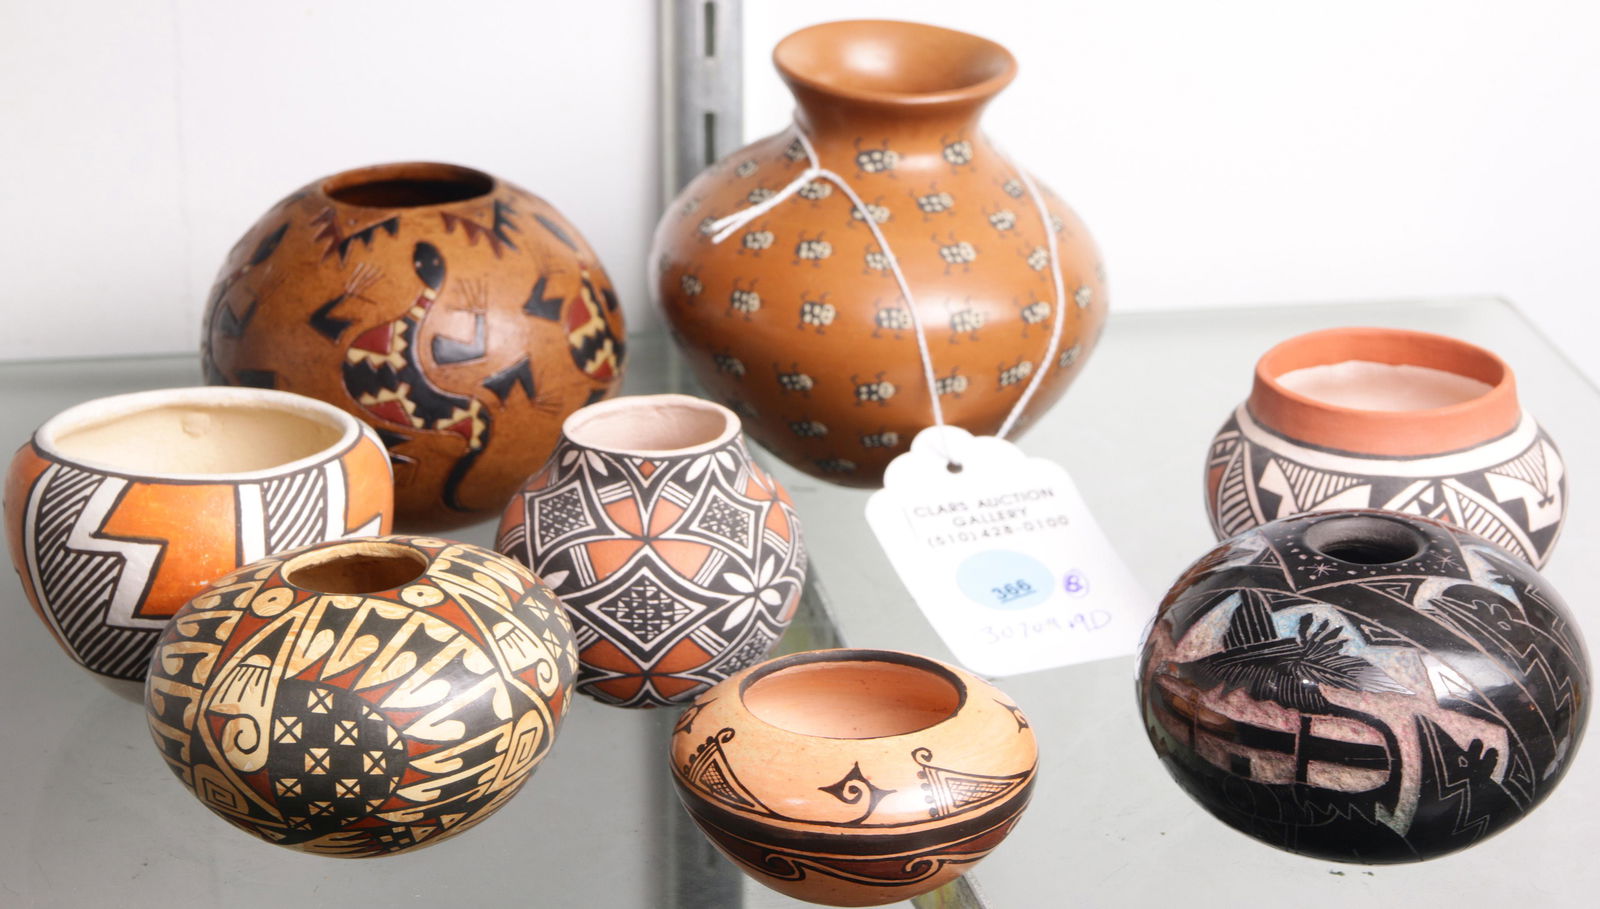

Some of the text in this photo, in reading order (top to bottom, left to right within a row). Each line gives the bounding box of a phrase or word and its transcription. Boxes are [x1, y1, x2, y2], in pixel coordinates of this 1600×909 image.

[913, 488, 1055, 518] CLARS AUCTION
[952, 505, 1027, 527] GALLERY
[991, 578, 1032, 600] 366
